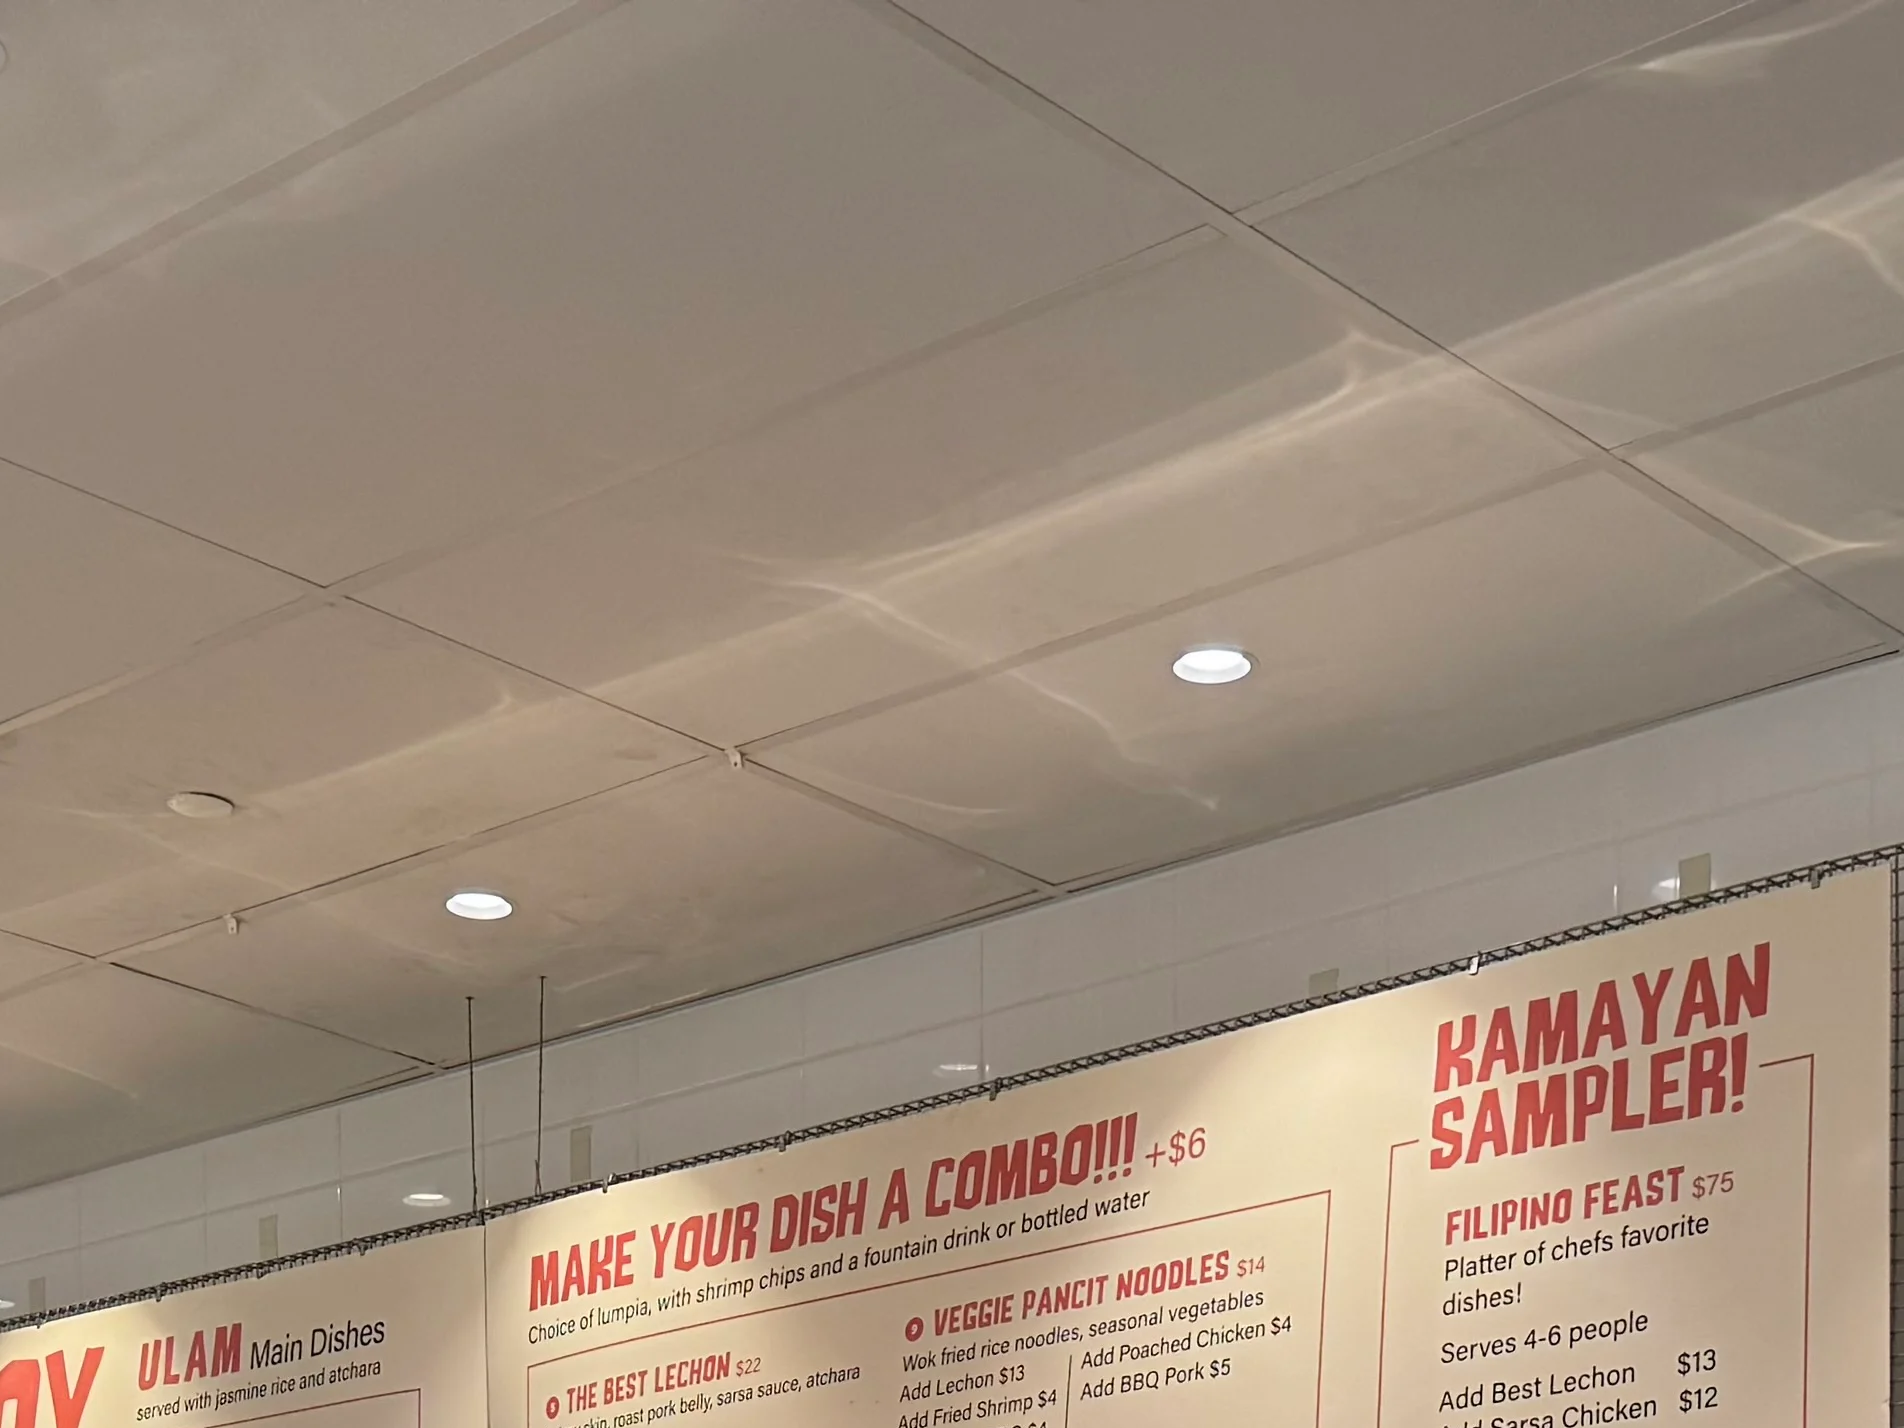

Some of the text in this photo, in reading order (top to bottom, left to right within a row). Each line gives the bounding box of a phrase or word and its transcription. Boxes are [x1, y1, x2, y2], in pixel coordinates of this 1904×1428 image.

[1433, 941, 1771, 1093] KAMAYAN
[1430, 1031, 1749, 1171] SAMPLER!
[528, 1111, 1206, 1312] MAKE YOUR DISH A COMBO!!! +$6
[1445, 1165, 1734, 1246] FILIPINO FEAST $75
[1445, 1215, 1709, 1282] Platter of chefs favorite
[934, 1249, 1265, 1337] VEGGIE PANCIT NOODLES $14
[1442, 1281, 1521, 1316] dishes!
[138, 1319, 385, 1392] ULAM Main Dishes
[1441, 1310, 1648, 1364] Serves 4-6 people
[136, 1361, 381, 1422] served with jasmine rice and atchara
[566, 1351, 761, 1415] THE BEST LECHON $22
[1439, 1348, 1716, 1413] Add Best Lechon $13
[1562, 1398, 1657, 1428] Chicken
[1679, 1386, 1718, 1414] $12
